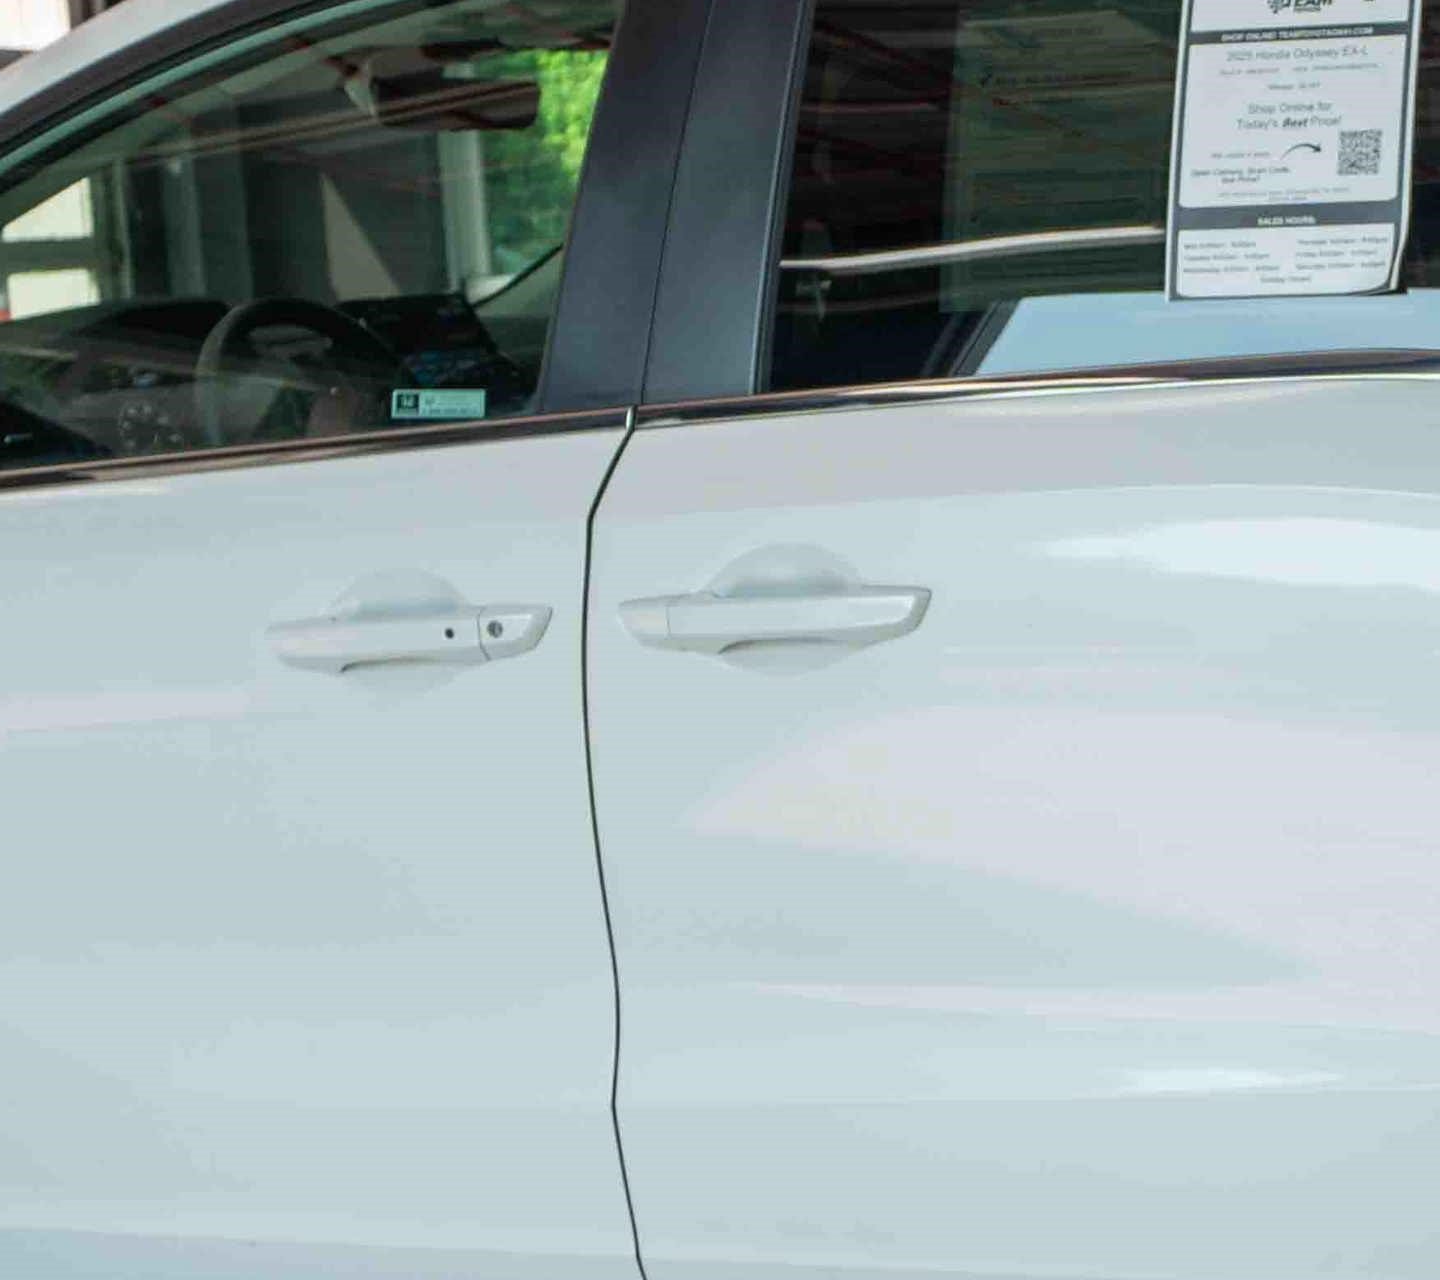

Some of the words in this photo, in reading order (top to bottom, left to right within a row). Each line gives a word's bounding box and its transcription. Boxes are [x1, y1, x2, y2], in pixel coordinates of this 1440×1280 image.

[1256, 49, 1290, 60] Honda
[1293, 47, 1339, 61] Odyssey
[1248, 103, 1276, 115] Shop
[1279, 102, 1314, 113] Online
[1317, 101, 1333, 111] for
[1236, 119, 1278, 130] Today's
[1282, 117, 1308, 128] Best
